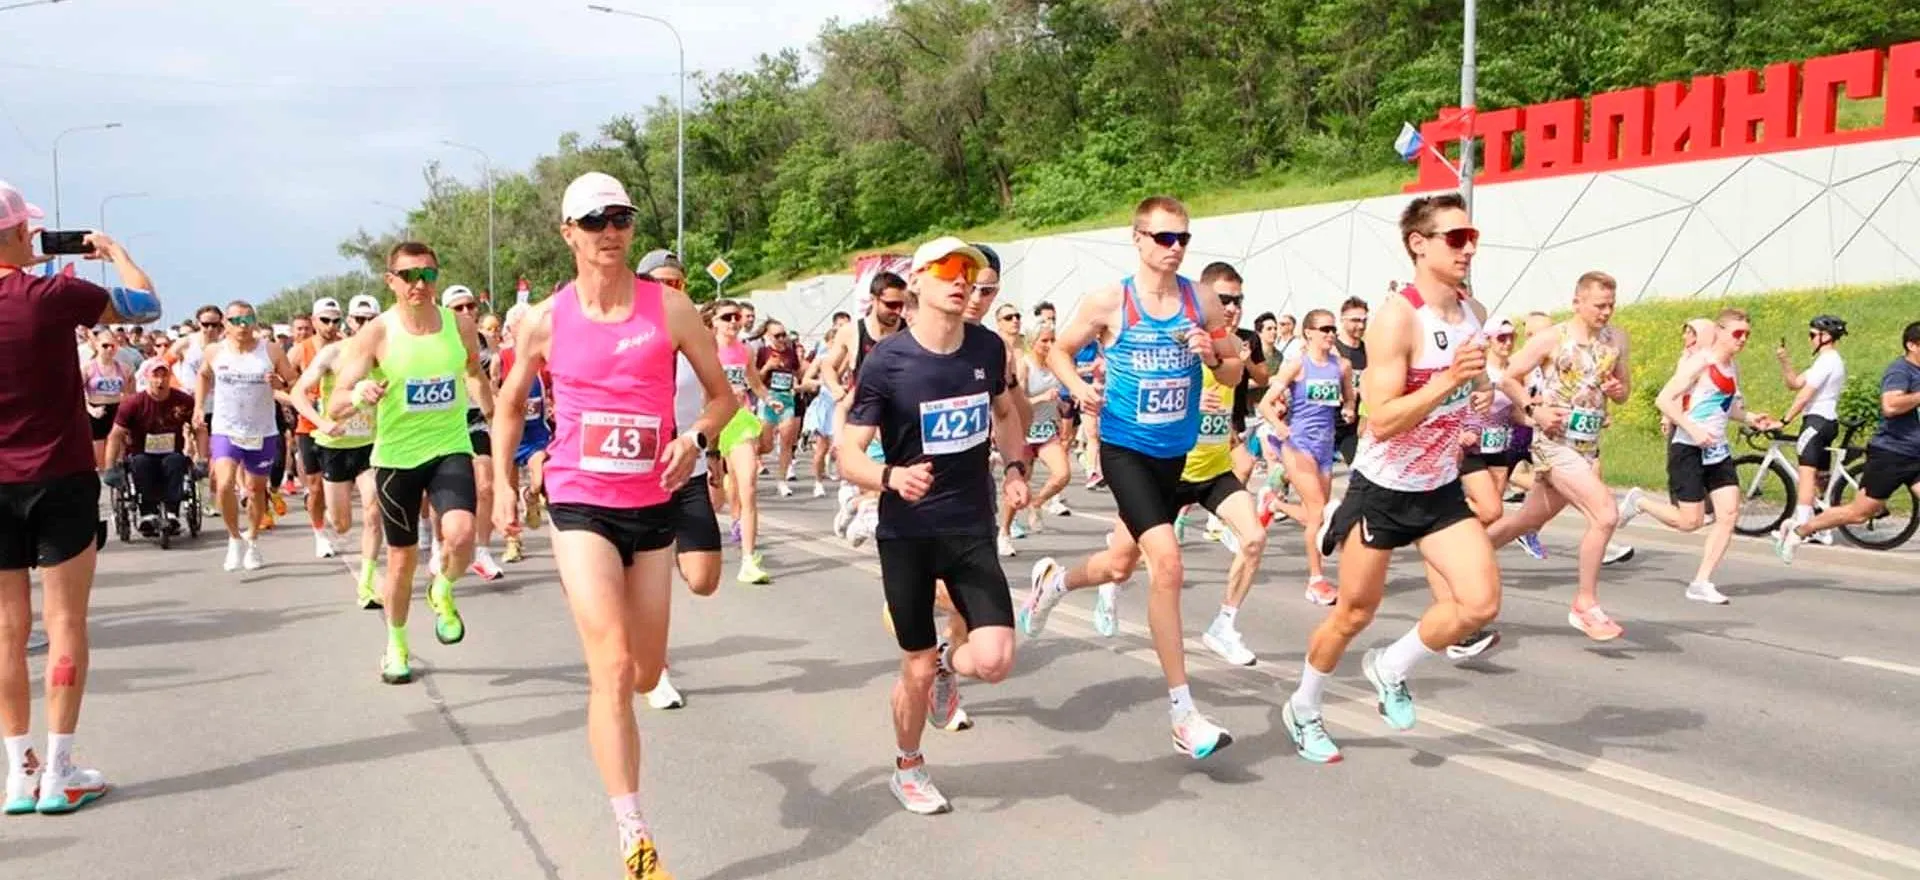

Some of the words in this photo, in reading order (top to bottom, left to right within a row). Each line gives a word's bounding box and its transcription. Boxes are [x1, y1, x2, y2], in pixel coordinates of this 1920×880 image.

[411, 382, 453, 403] 466
[1146, 388, 1185, 413] 548
[930, 407, 981, 440] 421
[600, 427, 641, 458] 43
